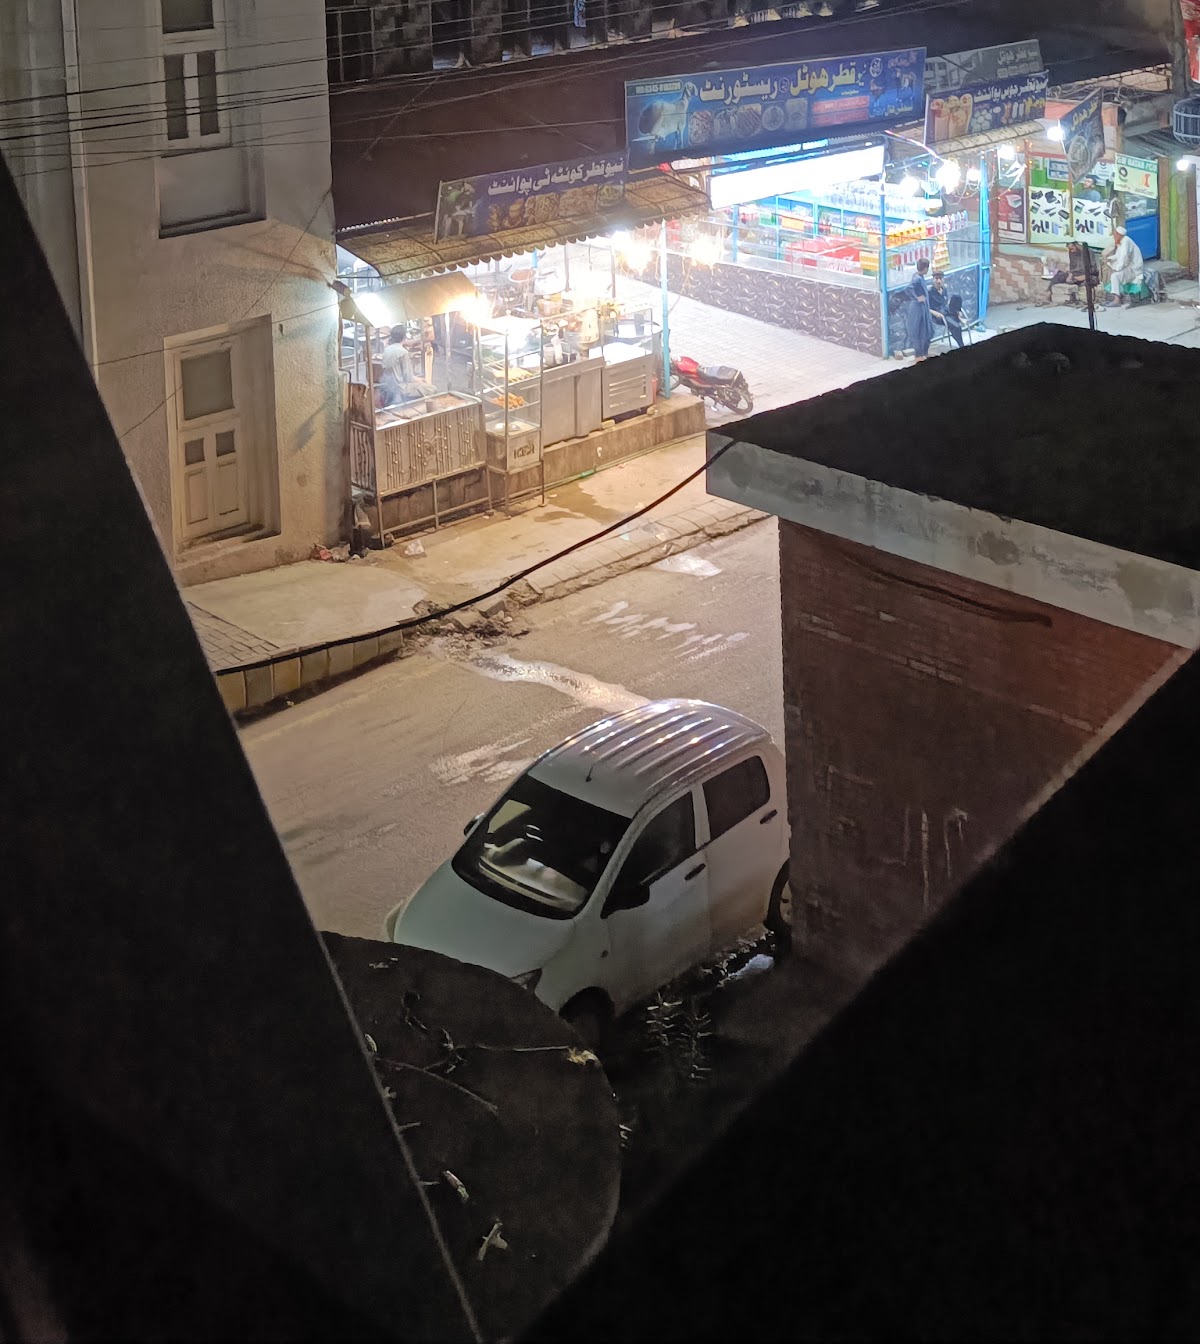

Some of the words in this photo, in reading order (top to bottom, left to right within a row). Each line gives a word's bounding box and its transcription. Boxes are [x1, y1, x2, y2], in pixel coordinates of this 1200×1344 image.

[699, 71, 780, 106] ریسٹورنٹ
[789, 63, 829, 97] ہوٹل
[827, 61, 857, 93] قطر
[532, 167, 551, 192] ٹی
[550, 163, 584, 185] کوئٹہ
[583, 159, 606, 182] قطر
[488, 174, 532, 196] پوائنٹ
